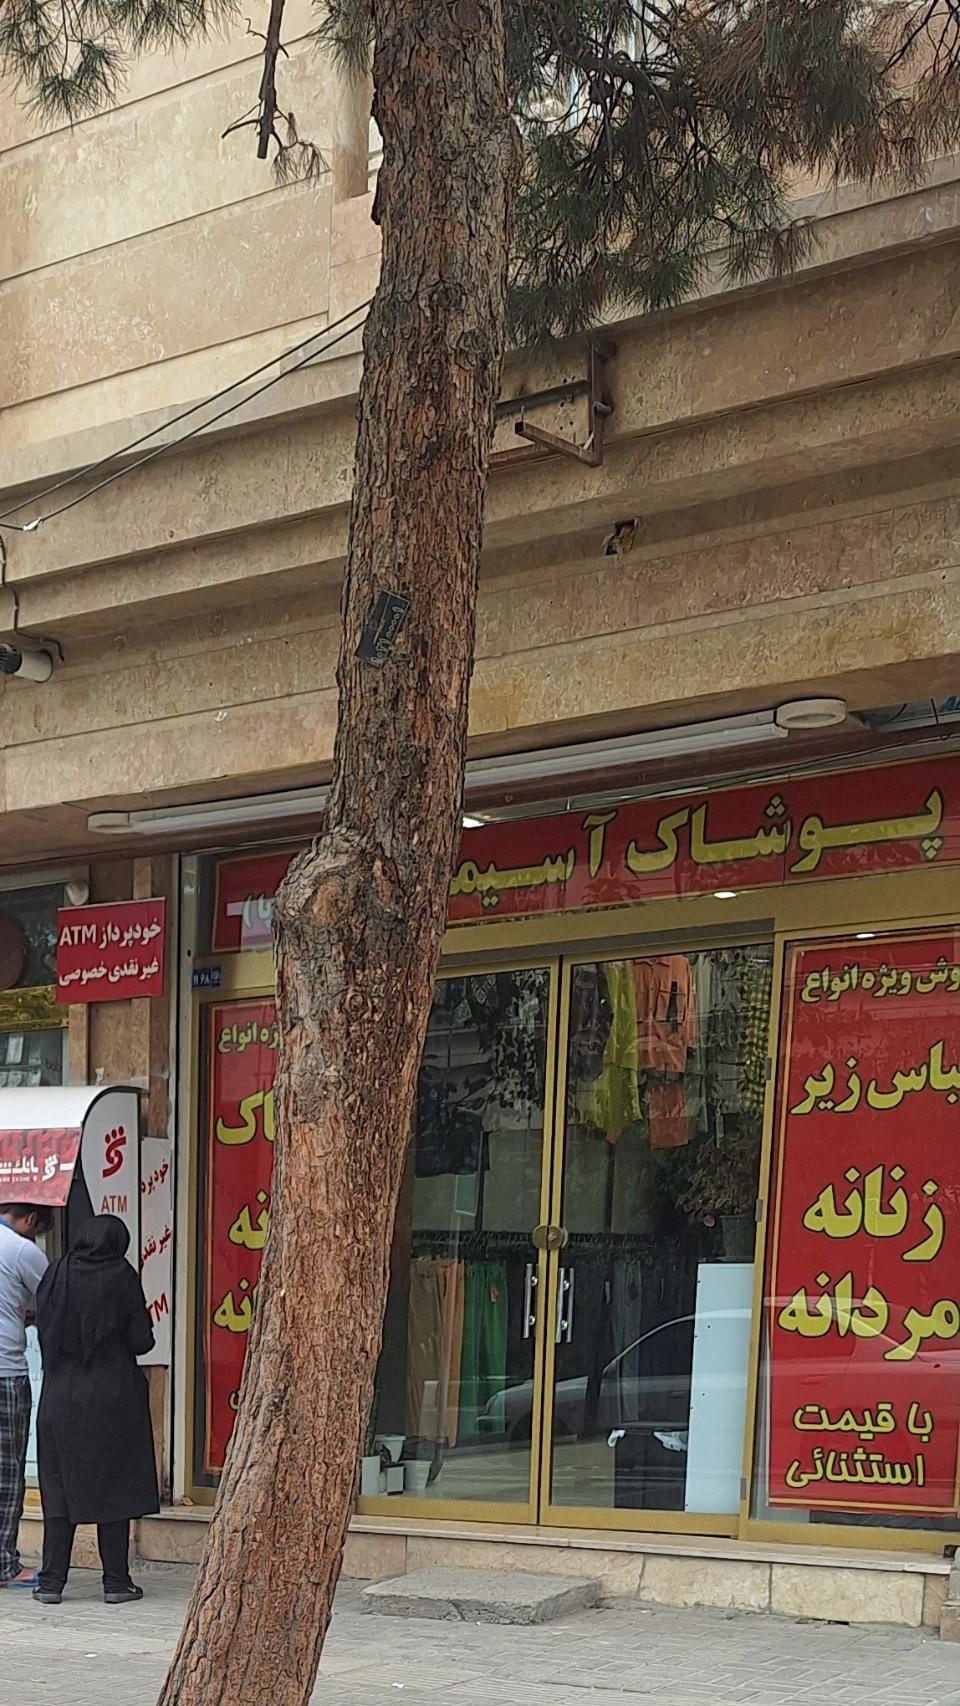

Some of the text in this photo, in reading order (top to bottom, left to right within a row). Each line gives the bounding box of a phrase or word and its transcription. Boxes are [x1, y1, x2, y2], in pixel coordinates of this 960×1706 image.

[624, 788, 944, 874] پوشاک
[59, 917, 162, 949] خودپرداز ATM
[58, 955, 159, 987] غیر نقدی خصوصی
[801, 963, 859, 1002] انواع
[862, 964, 912, 998] ویژه
[218, 1020, 258, 1054] انواع
[790, 1040, 960, 1115] باس زیر
[141, 1160, 170, 1195] خودپرد
[101, 1195, 128, 1213] ATM
[802, 1163, 945, 1262] زنانه
[145, 1292, 170, 1328] TM
[778, 1271, 960, 1361] مردانه
[793, 1401, 934, 1443] با قیمت
[784, 1447, 926, 1488] استثنائی
